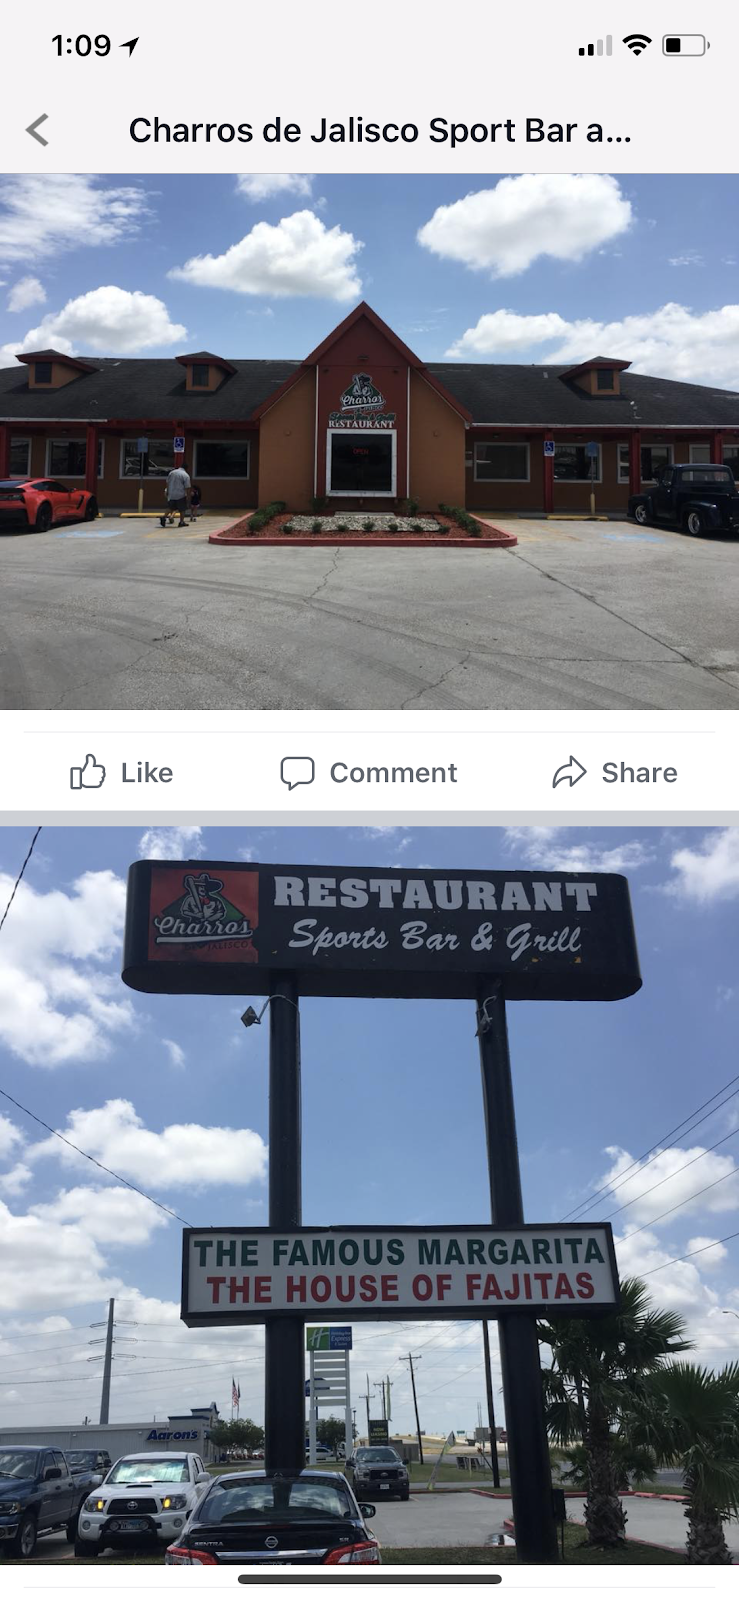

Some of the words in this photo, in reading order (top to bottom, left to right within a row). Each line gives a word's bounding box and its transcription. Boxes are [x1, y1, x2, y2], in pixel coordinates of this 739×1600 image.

[341, 394, 385, 406] Charros
[328, 420, 394, 428] RESTAURANT
[274, 876, 598, 912] RESTAURANT
[154, 916, 253, 935] Charros
[207, 941, 249, 951] JALISCO
[288, 918, 389, 956] Sports
[400, 920, 459, 951] Bar
[471, 922, 493, 951] &
[506, 923, 581, 962] Grill
[194, 1240, 259, 1267] THE
[272, 1239, 405, 1266] FAMOUS
[418, 1238, 605, 1266] MARGARITA
[206, 1276, 272, 1304] THE
[286, 1275, 399, 1303] HOUSE
[412, 1274, 453, 1301] OF
[466, 1272, 595, 1301] FAJITAS
[146, 1429, 199, 1441] Aaron's
